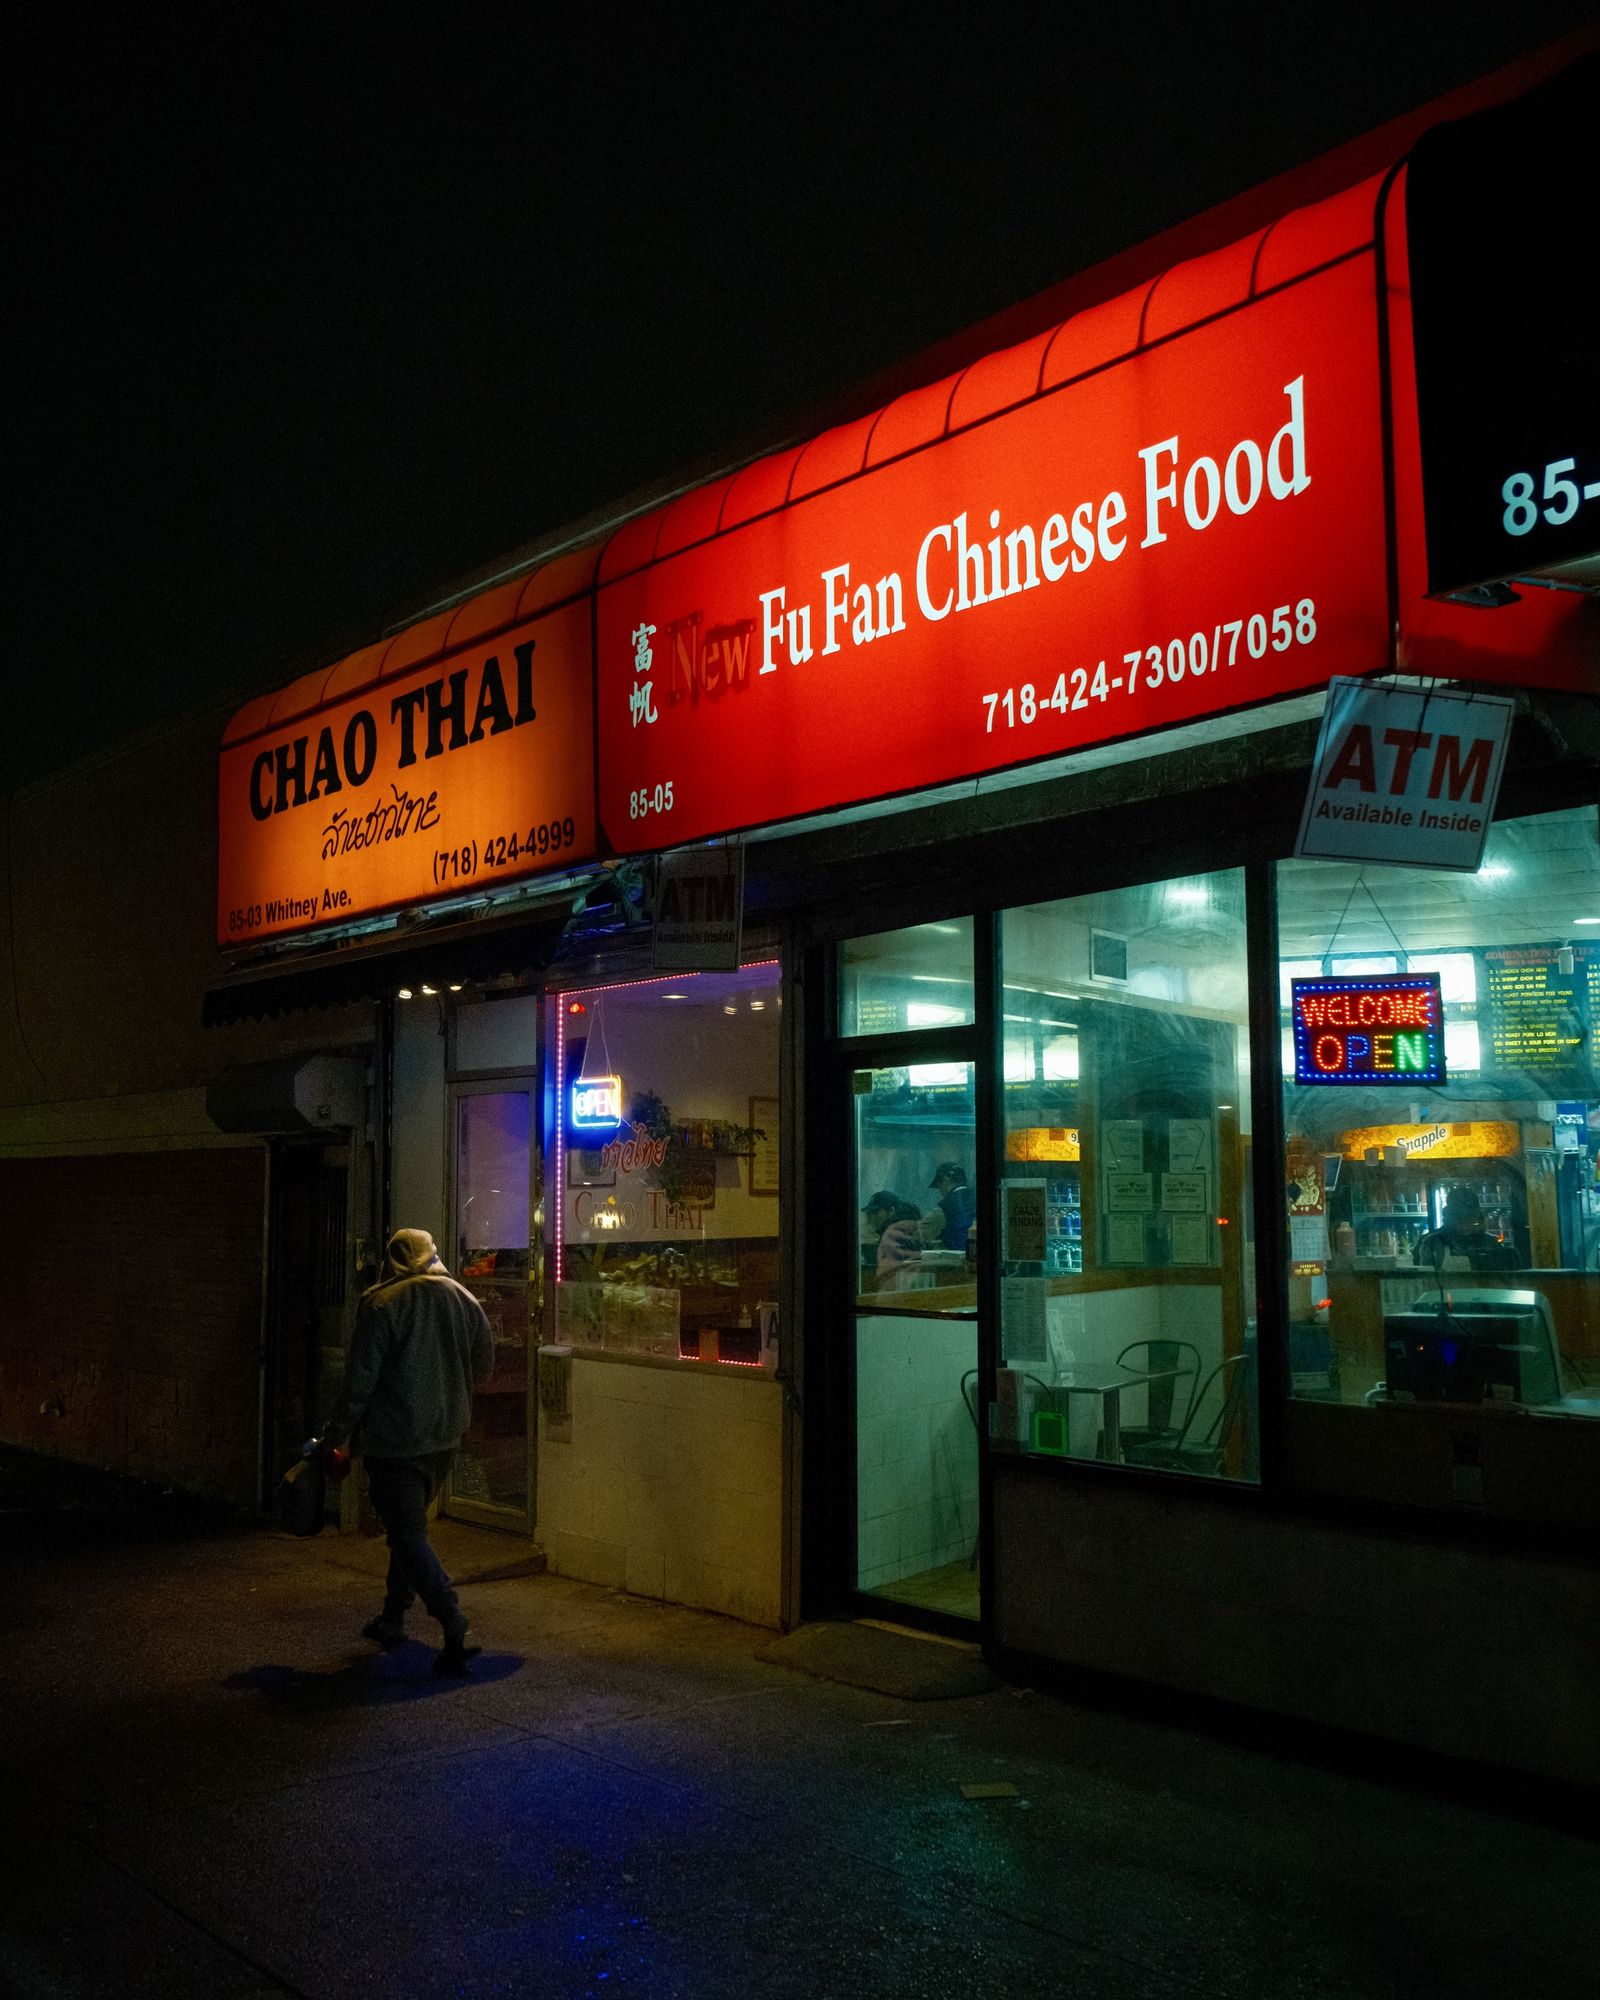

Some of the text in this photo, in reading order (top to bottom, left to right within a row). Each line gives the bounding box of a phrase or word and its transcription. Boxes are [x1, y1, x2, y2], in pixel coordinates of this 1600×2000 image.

[1502, 458, 1600, 536] 85-
[665, 374, 1312, 704] New Fu Fan Chinese Food
[983, 598, 1317, 733] 718-424-7300/7058
[249, 639, 537, 822] CHAO THAI
[1322, 725, 1495, 804] ATM
[630, 781, 674, 820] 85-05
[1315, 801, 1482, 833] Available Inside
[433, 817, 575, 884] (718) 424-4999
[229, 888, 352, 932] 85-03 Whitney Ave.
[660, 876, 737, 922] ATM
[1301, 993, 1430, 1026] WELCOME
[1316, 1034, 1423, 1070] OPEN
[577, 1089, 618, 1117] OPEN
[1396, 1125, 1447, 1153] Snapple
[646, 1189, 705, 1230] THAI
